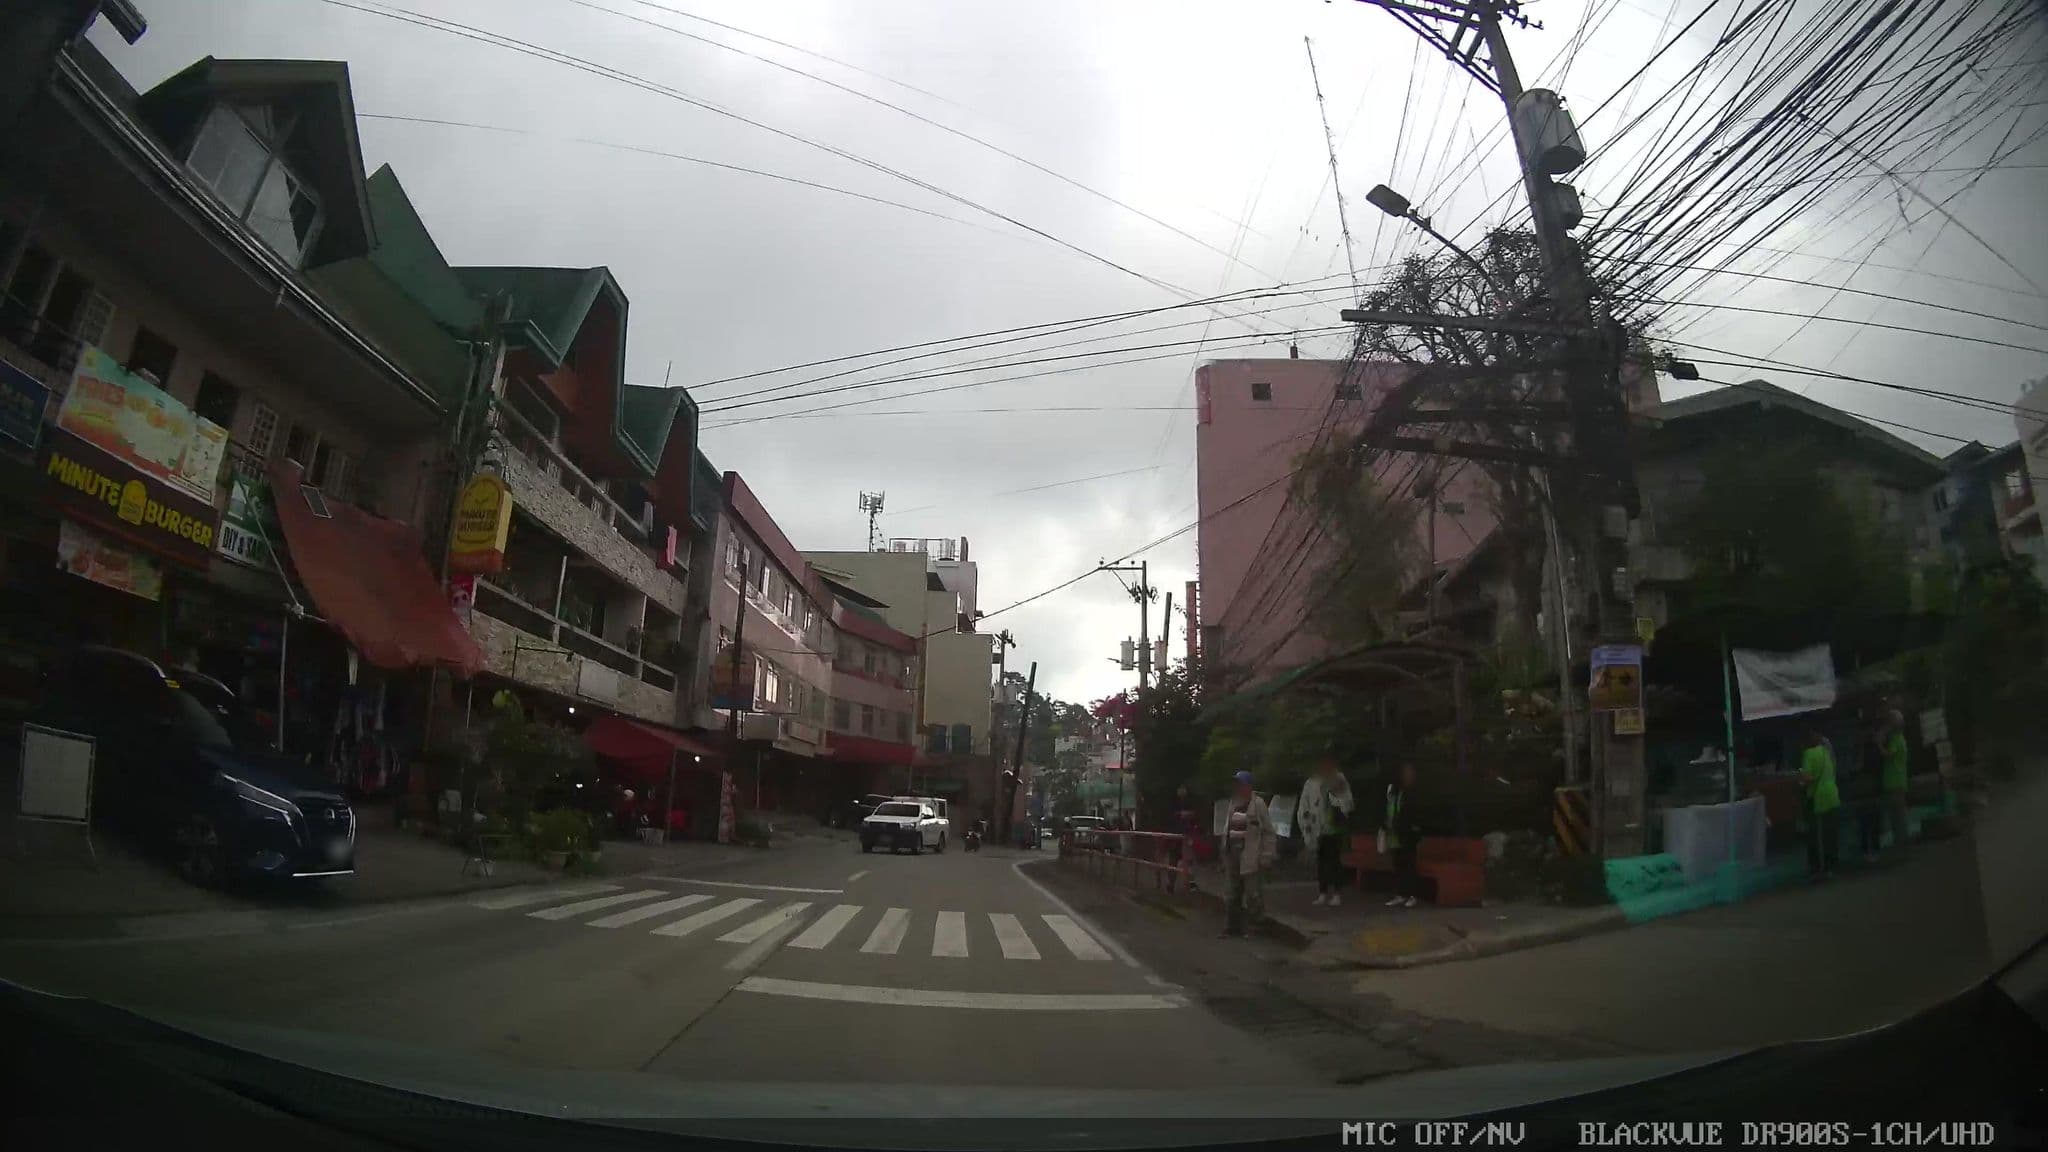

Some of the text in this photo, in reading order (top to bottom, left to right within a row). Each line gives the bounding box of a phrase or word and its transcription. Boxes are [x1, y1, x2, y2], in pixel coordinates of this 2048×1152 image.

[47, 452, 121, 508] MINUTE
[144, 496, 214, 551] BURGER
[222, 526, 239, 552] DIY
